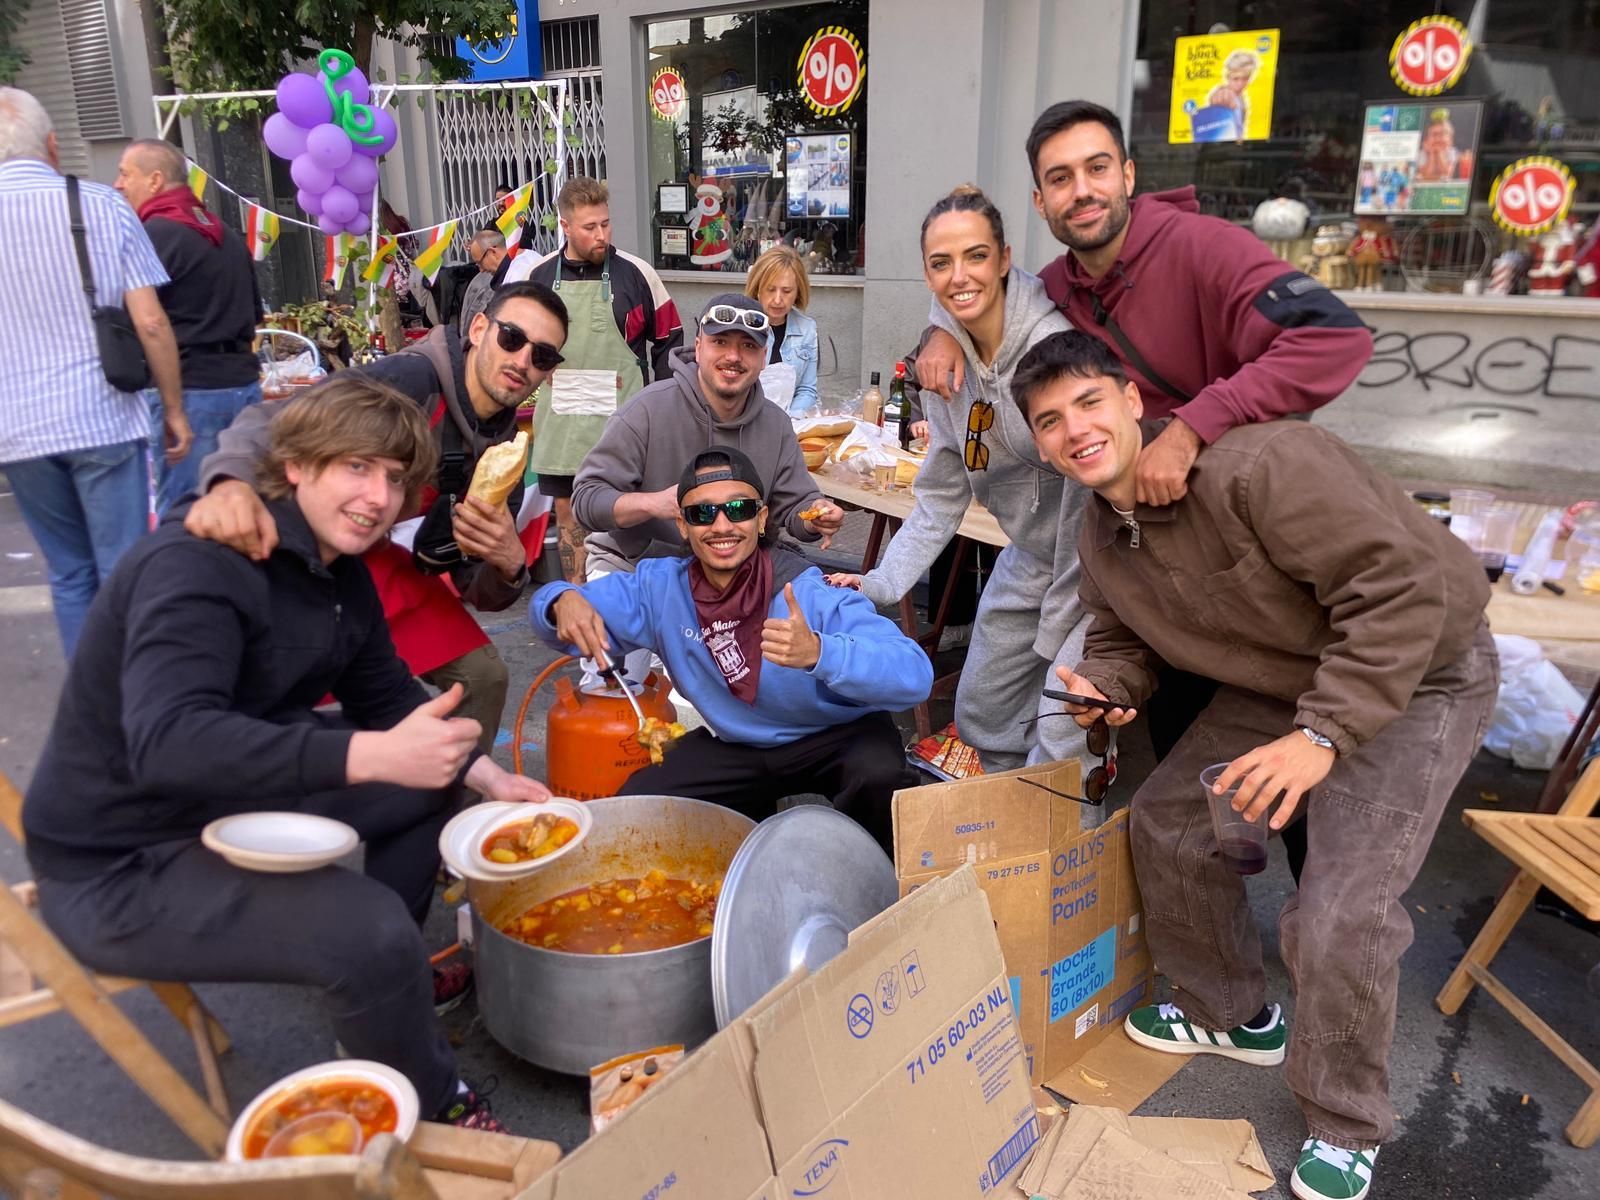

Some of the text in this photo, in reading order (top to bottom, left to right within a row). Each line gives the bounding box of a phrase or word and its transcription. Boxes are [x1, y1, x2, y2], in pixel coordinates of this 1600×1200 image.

[955, 820, 996, 834] 50935-11
[987, 862, 1040, 880] 79 27 57 ES
[1052, 888, 1097, 926] Pants
[1052, 941, 1096, 979] NOCHE
[1051, 962, 1096, 998] Grande
[1051, 971, 1105, 1018] 80 (8x10)
[906, 1056, 925, 1084] 71
[928, 1036, 946, 1065] 05
[948, 1002, 986, 1047] 60-03
[987, 986, 1008, 1013] NL
[803, 1149, 838, 1186] TENA
